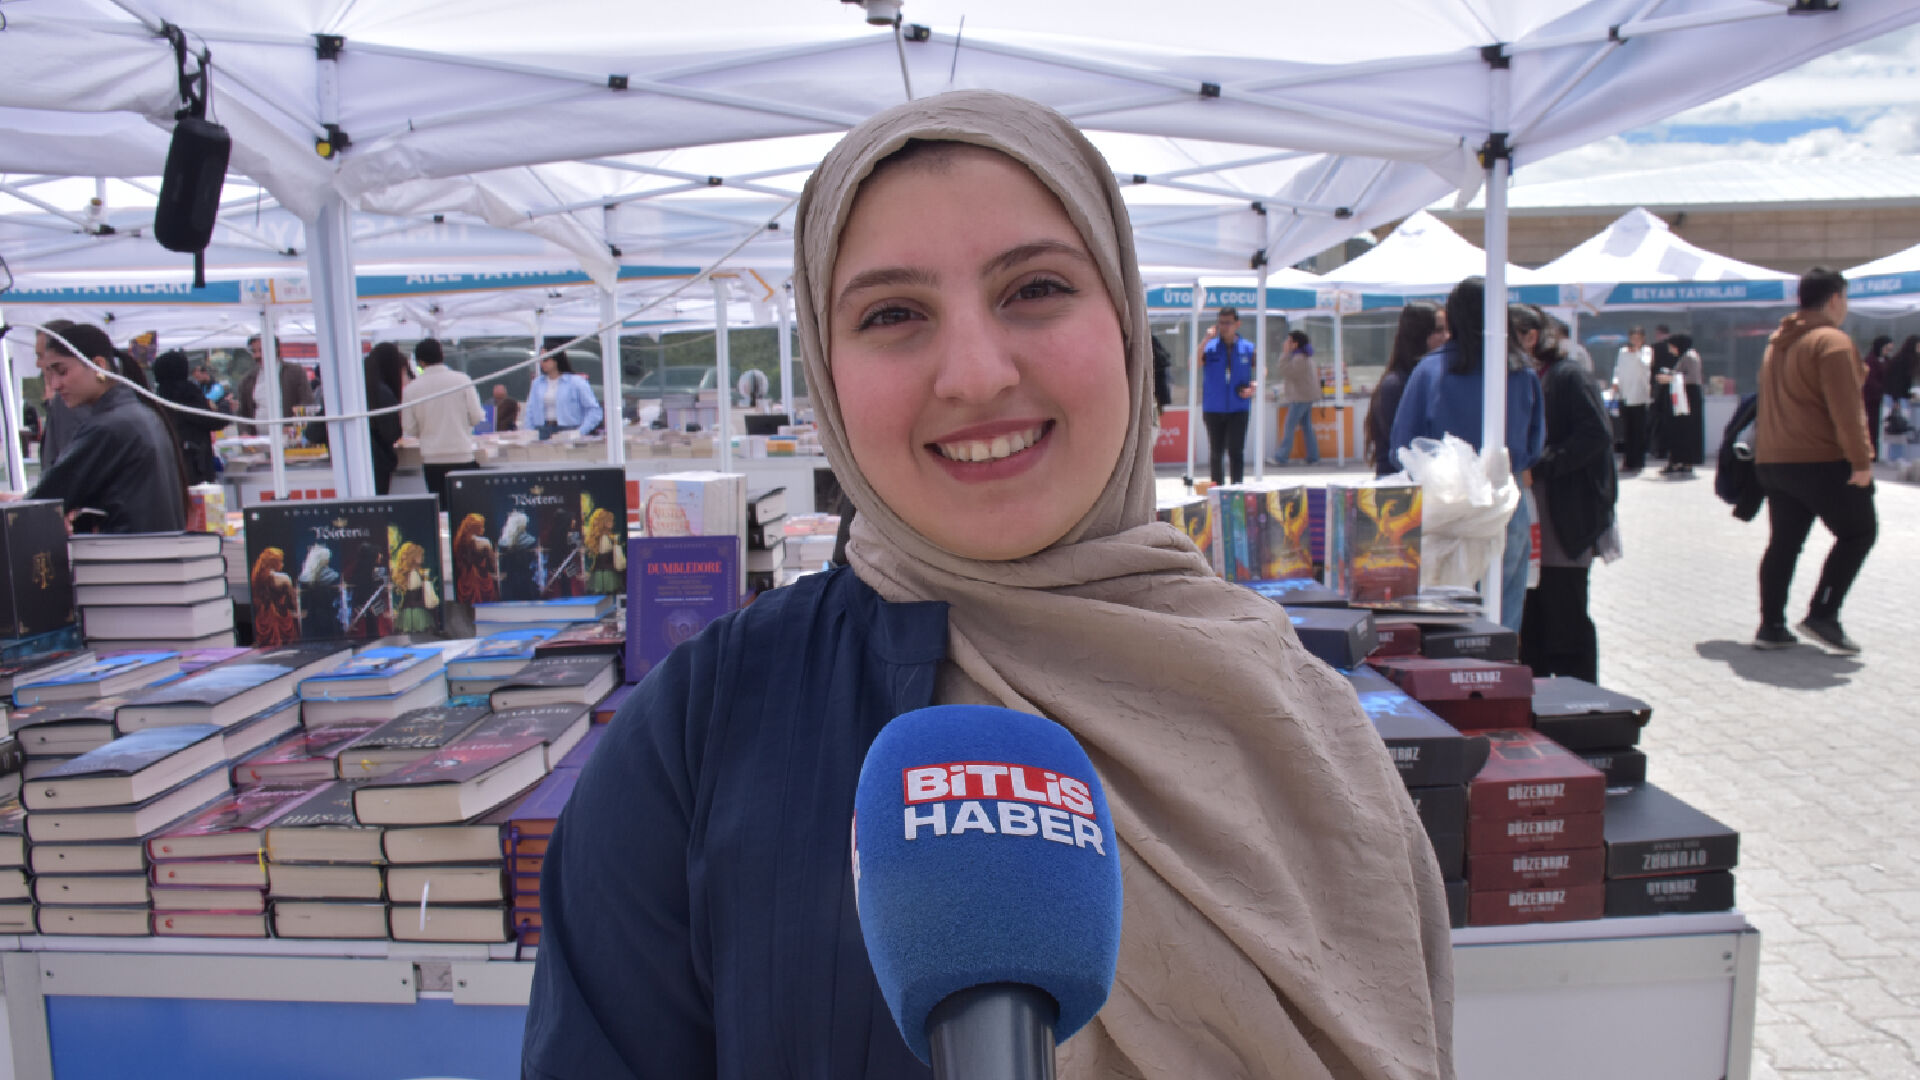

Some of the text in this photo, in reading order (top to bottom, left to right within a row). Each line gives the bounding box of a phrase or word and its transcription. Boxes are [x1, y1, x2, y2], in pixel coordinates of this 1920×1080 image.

[1632, 285, 1747, 299] BEYAN YAYINLARI
[647, 561, 723, 575] DUMBLEDORE
[904, 801, 1106, 856] HABER
